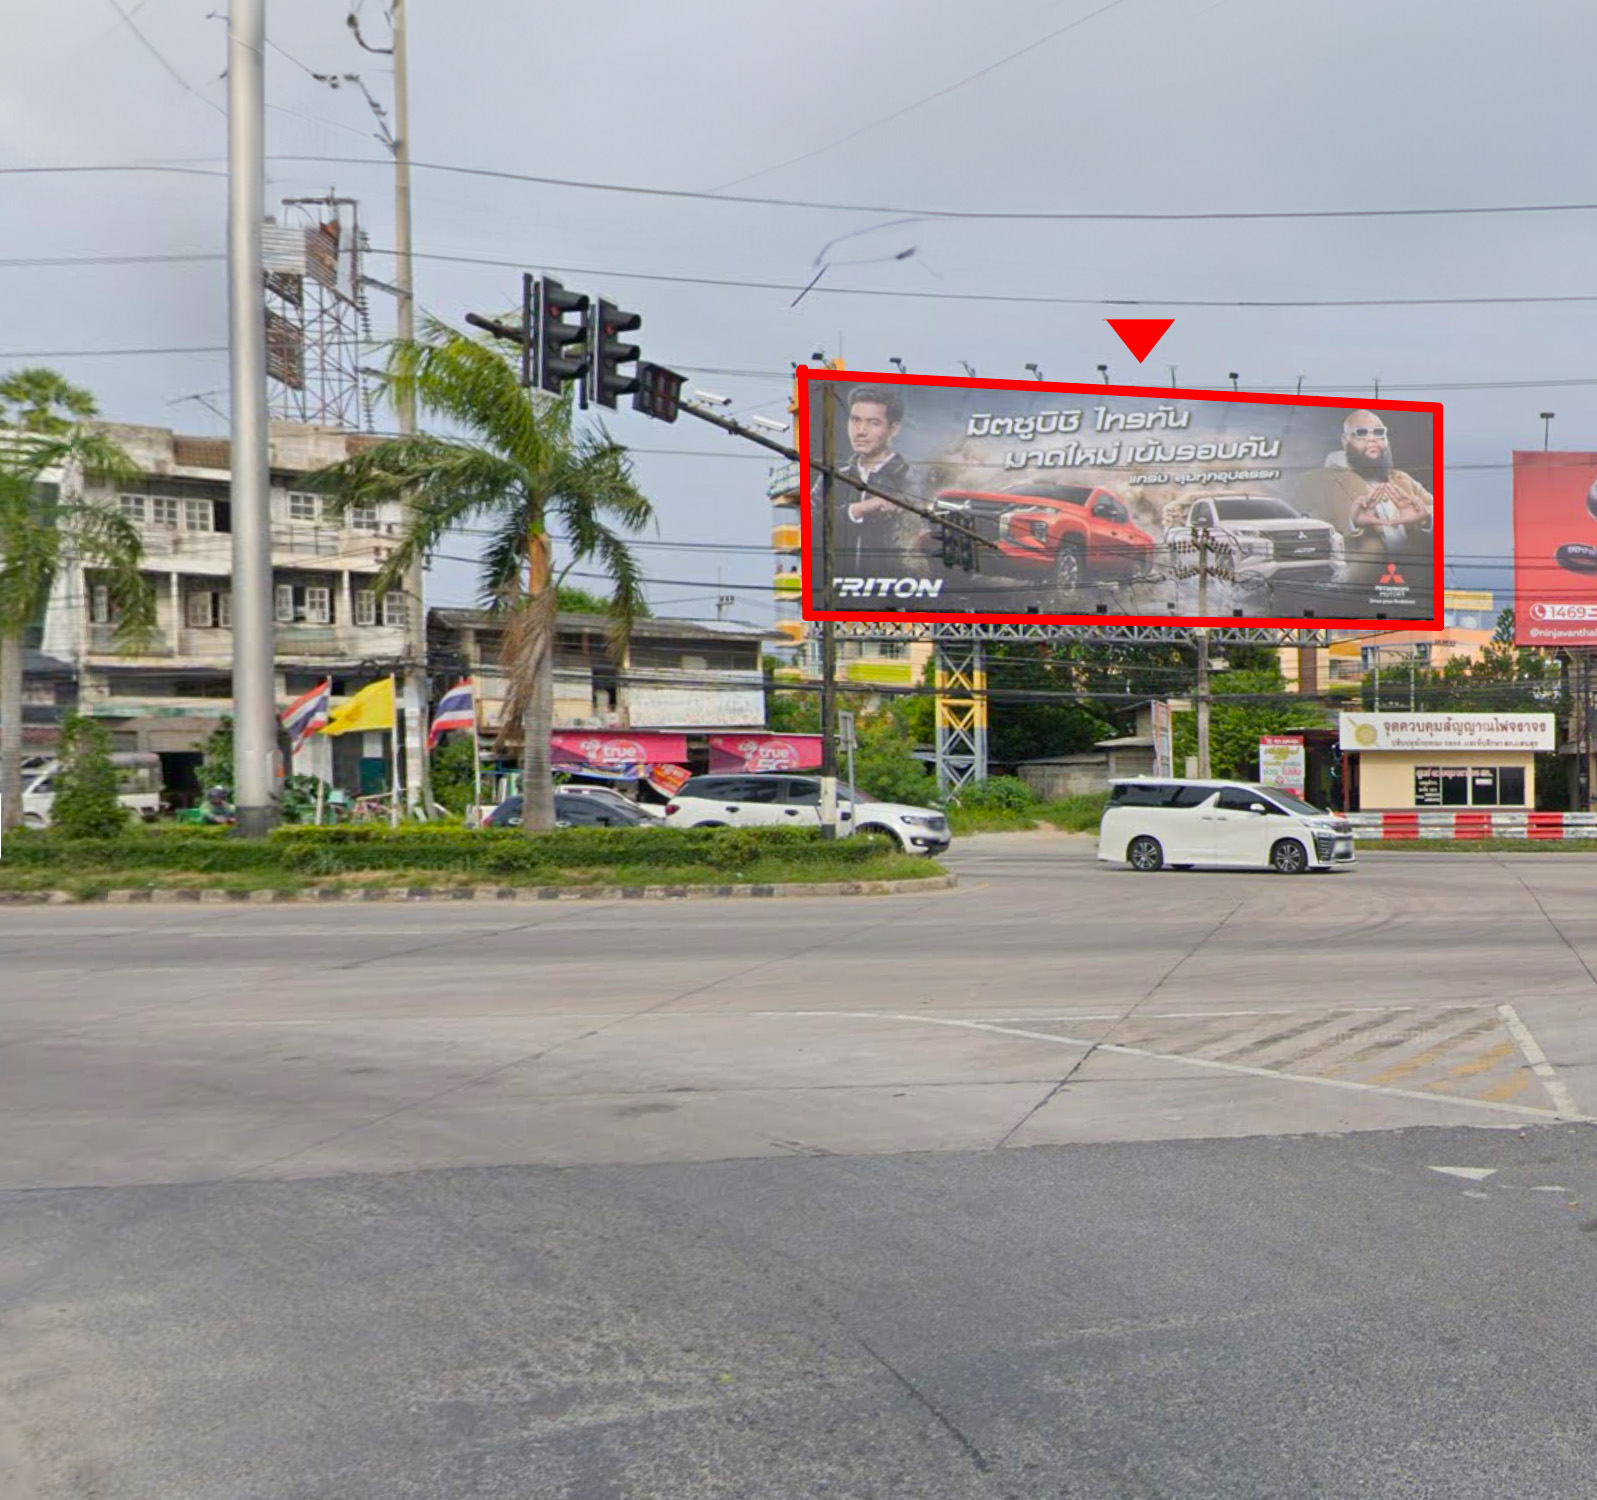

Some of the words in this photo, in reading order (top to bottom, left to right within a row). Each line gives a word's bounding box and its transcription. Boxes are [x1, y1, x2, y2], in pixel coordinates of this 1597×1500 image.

[1094, 406, 1191, 432] ไทรทัน
[1005, 439, 1120, 470] มาดใหม่
[1126, 435, 1280, 466] เข้มรอบคัน
[1550, 606, 1586, 618] 1469
[1383, 717, 1547, 737] จุดควบคุมสัญญาณไฟจราจร
[603, 746, 637, 757] true
[759, 747, 789, 758] true
